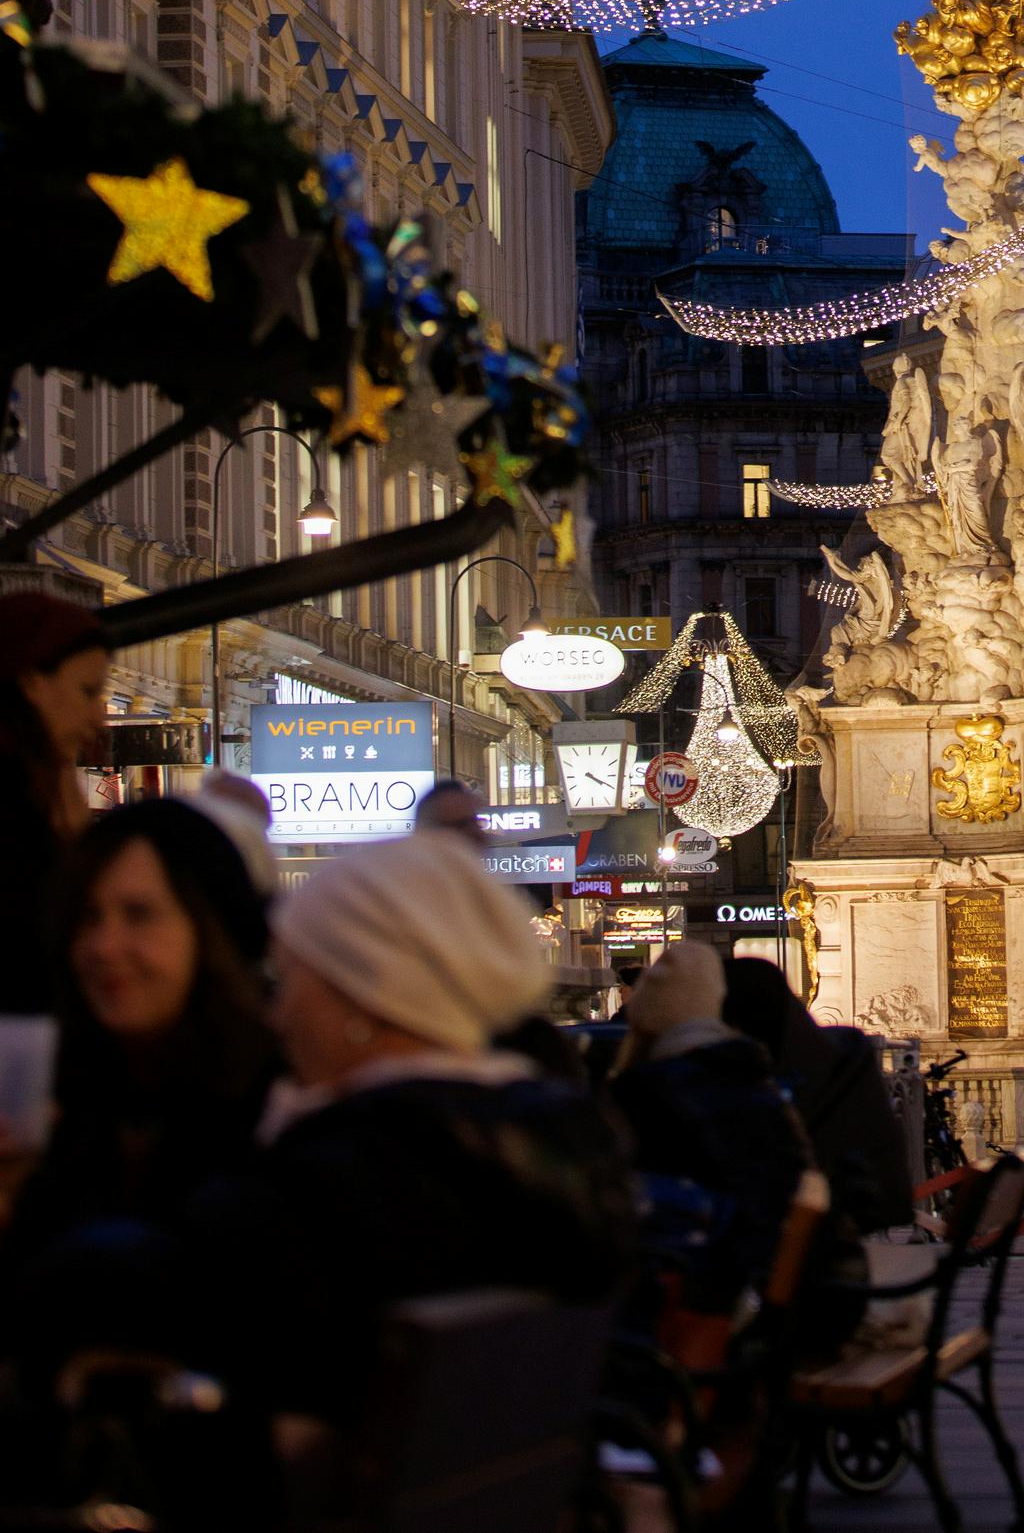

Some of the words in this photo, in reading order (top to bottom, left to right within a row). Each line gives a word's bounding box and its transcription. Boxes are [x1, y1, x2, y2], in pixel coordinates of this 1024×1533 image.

[267, 716, 416, 737] wienerin
[269, 780, 417, 813] BRAMO
[276, 822, 413, 833] COIFFEUR
[481, 854, 550, 874] watch
[672, 862, 713, 872] SPRESSO
[572, 880, 612, 896] CAMPER
